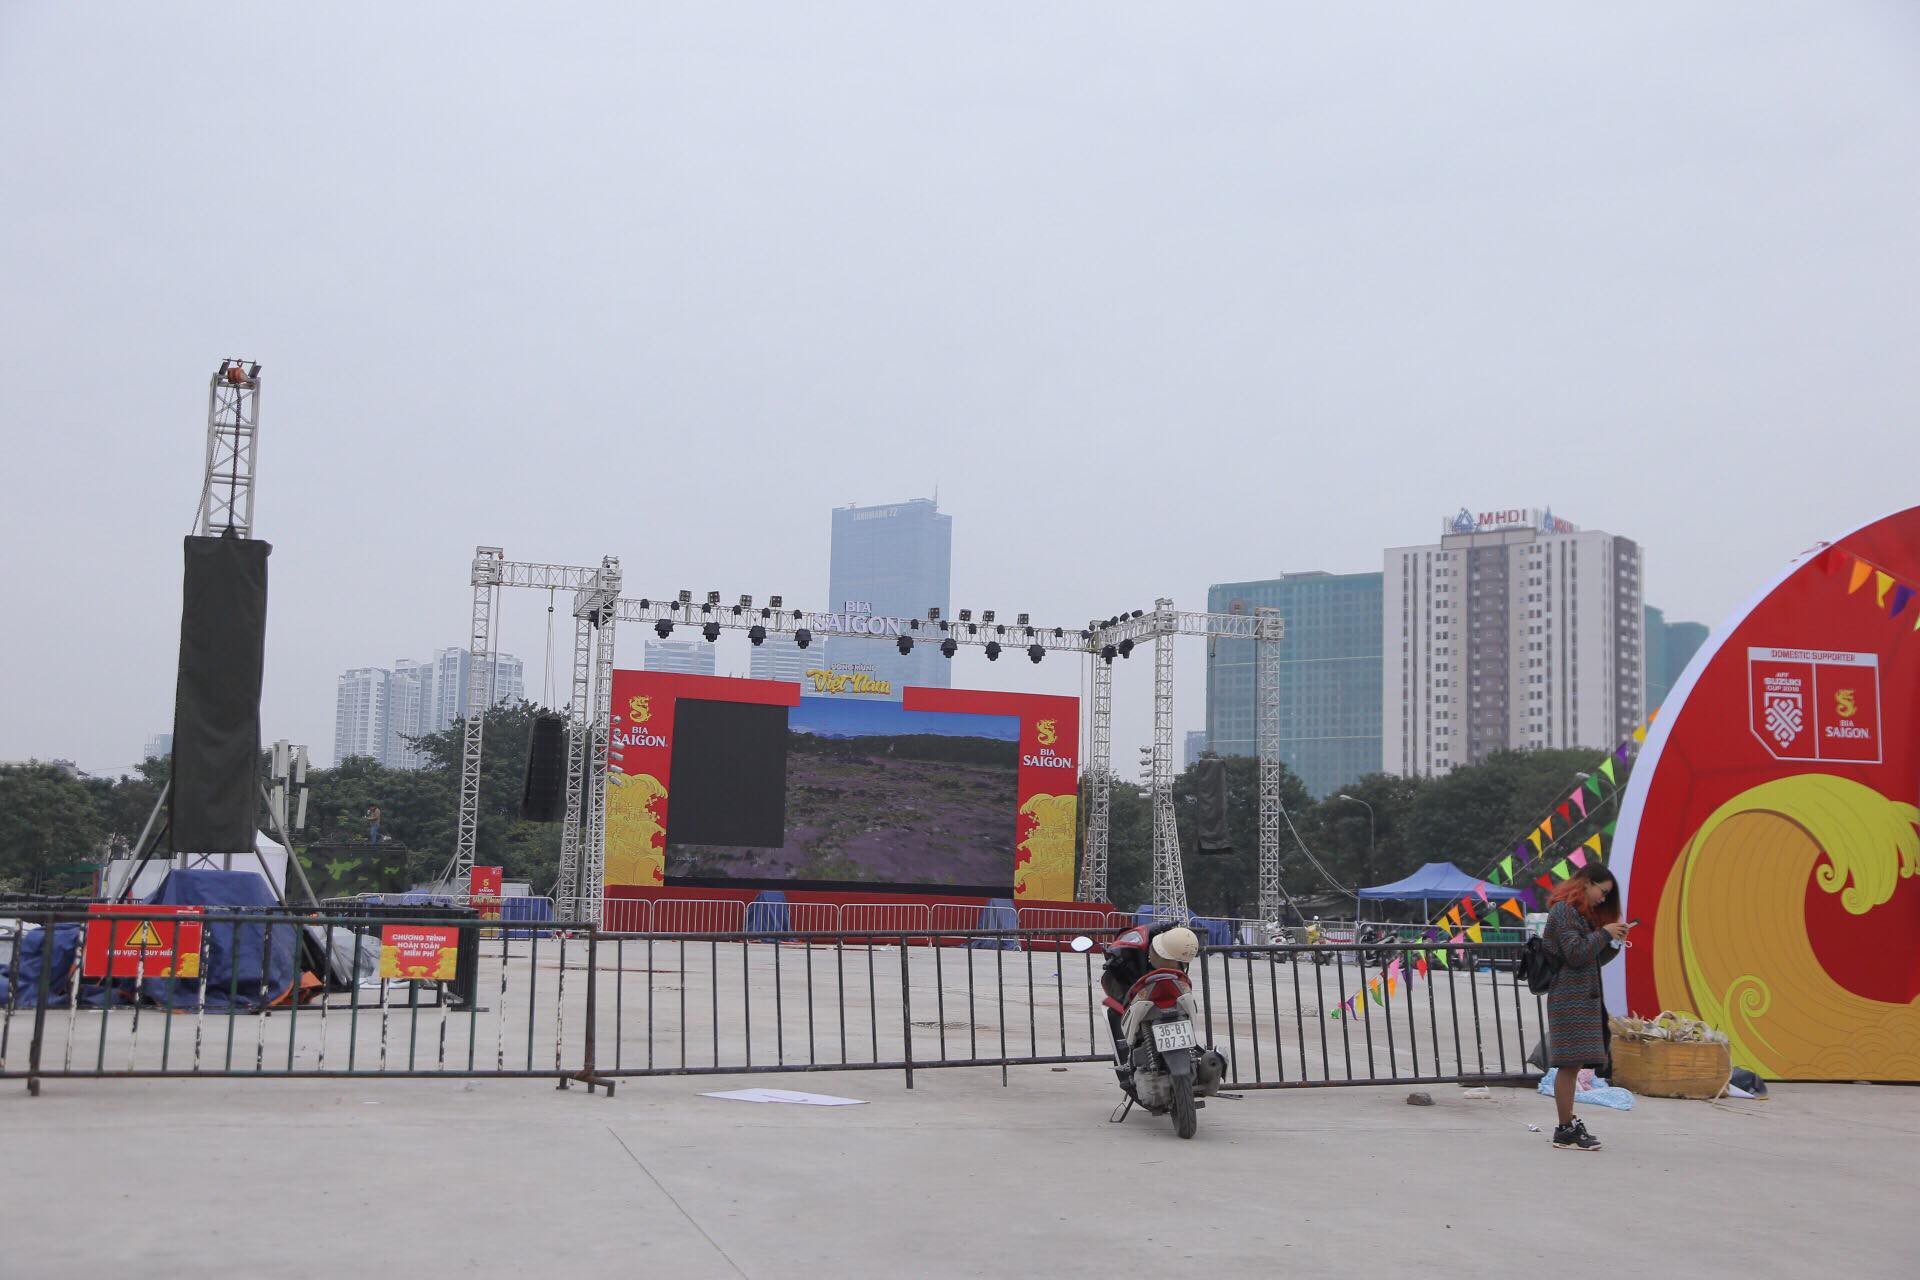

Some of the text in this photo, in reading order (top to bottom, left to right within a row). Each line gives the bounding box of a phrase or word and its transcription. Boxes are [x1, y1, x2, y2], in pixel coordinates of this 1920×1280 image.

[1479, 509, 1526, 525] MHDI
[845, 600, 872, 613] BIA
[812, 613, 901, 636] SAIGON
[1771, 649, 1857, 662] DOMESTIC SUPPORTER
[1840, 719, 1855, 727] BIA
[632, 726, 649, 735] BIA
[1825, 726, 1870, 739] SAIGON
[1040, 748, 1056, 756] BIA
[1023, 755, 1072, 768] SAIGON
[1159, 1023, 1187, 1037] 36-B1
[1158, 1034, 1192, 1049] 787.31
